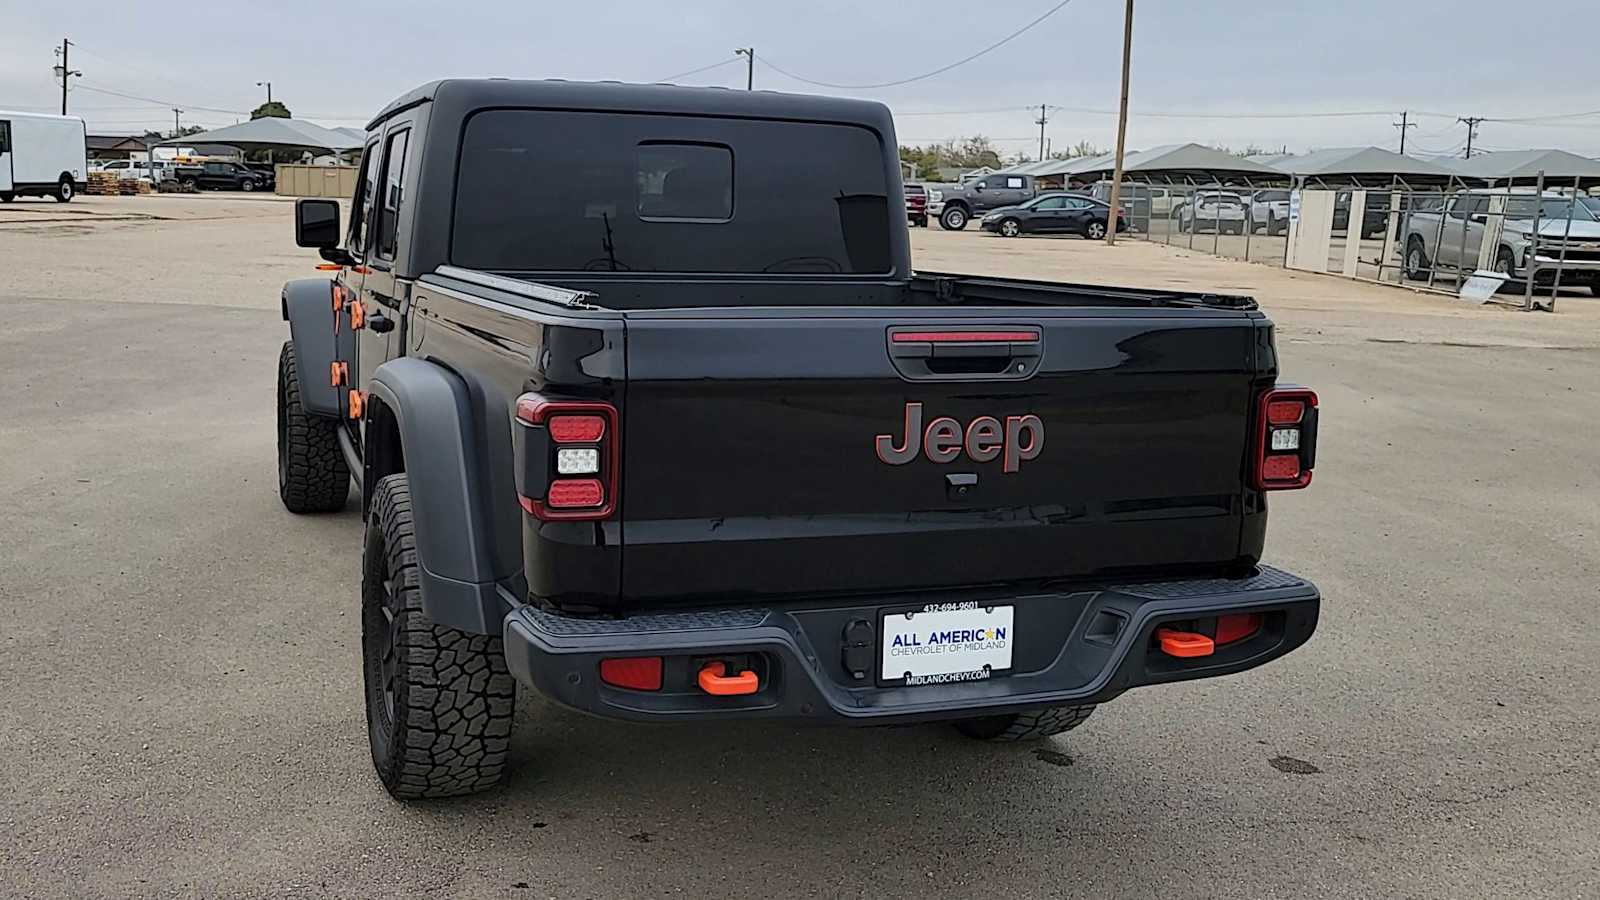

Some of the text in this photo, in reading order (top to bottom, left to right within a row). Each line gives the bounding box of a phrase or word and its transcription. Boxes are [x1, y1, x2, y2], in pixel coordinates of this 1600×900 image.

[875, 402, 1045, 473] Jeep
[923, 601, 979, 613] 432-694-9601
[892, 633, 921, 647] ALL
[891, 640, 1006, 656] CHEVROLET OF MIDLAND
[906, 671, 990, 685] MIDLANDCHEVY.COM
